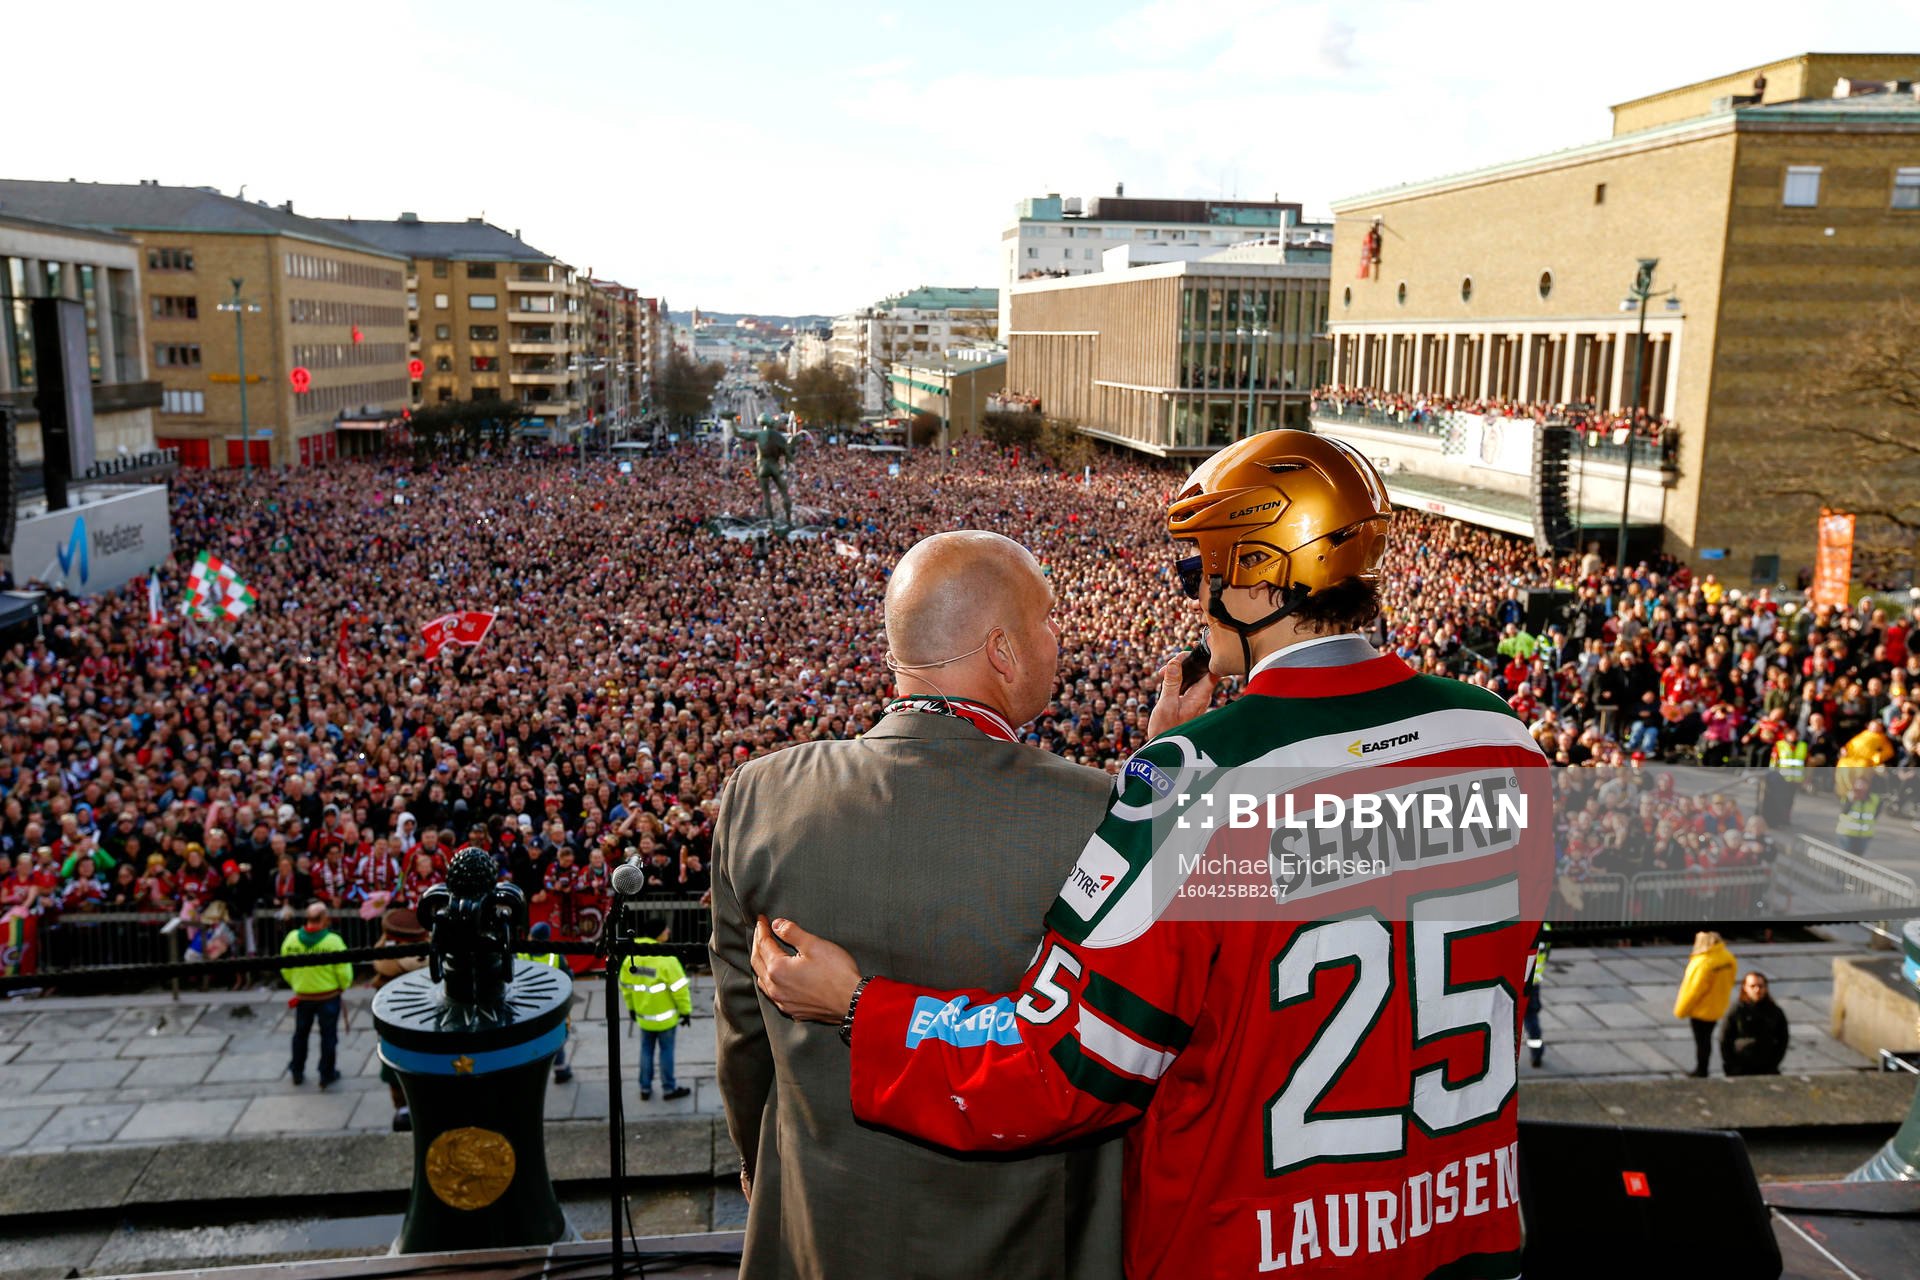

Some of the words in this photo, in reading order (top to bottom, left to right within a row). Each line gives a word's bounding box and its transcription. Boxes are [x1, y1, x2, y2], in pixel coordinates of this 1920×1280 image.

[1229, 500, 1282, 520] EASTON
[1361, 731, 1420, 753] EASTON
[1072, 867, 1100, 899] TYRE
[1015, 935, 1083, 1026] 5
[1264, 872, 1520, 1178] 25
[1257, 1141, 1518, 1273] LAURDSEN
